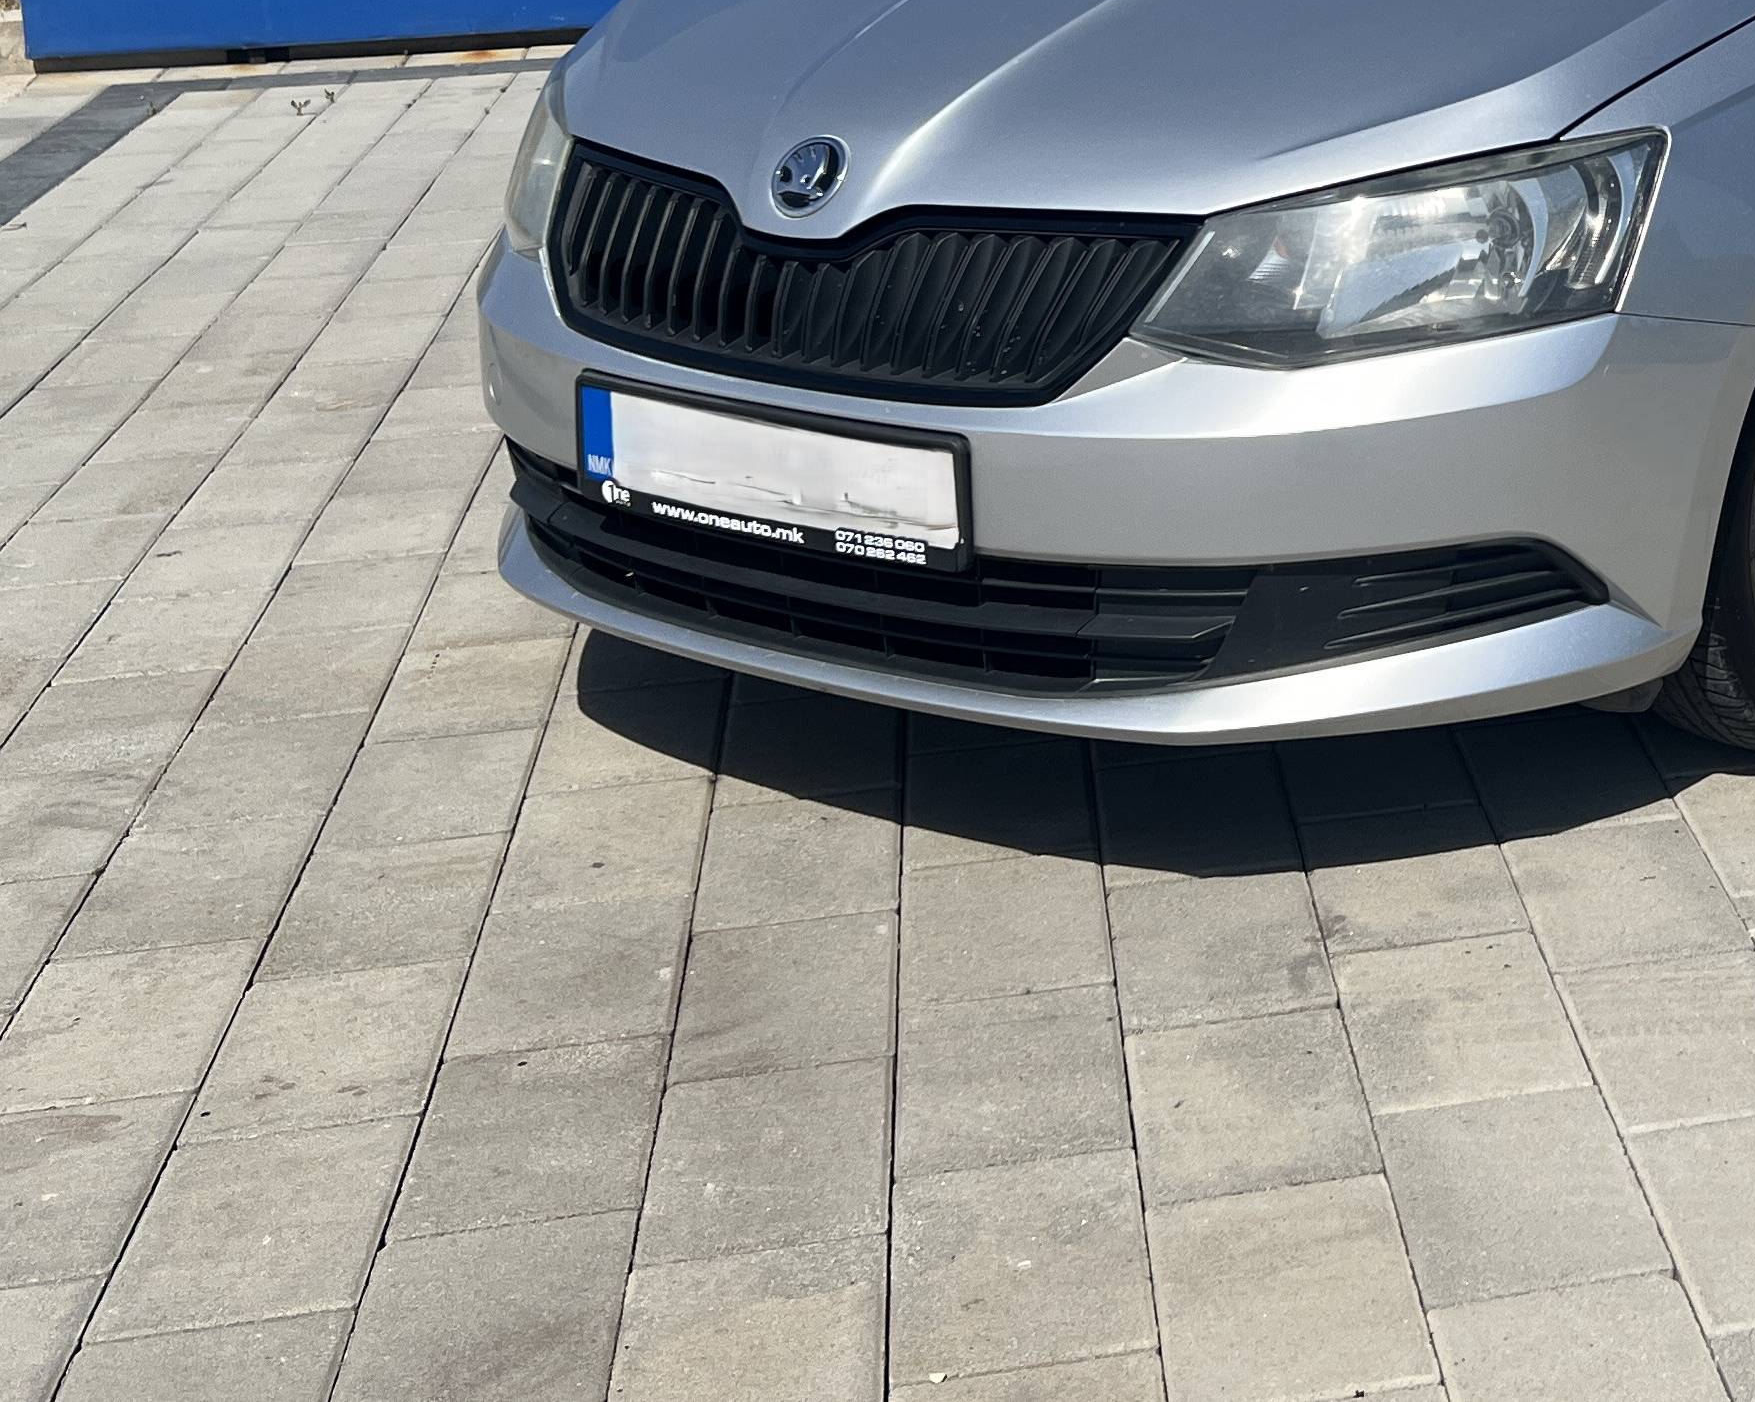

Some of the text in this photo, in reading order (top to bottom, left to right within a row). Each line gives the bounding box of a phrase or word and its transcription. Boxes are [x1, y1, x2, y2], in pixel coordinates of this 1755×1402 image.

[651, 501, 805, 544] www.oneauto.mk
[835, 530, 862, 544] 071
[835, 542, 865, 556] 070
